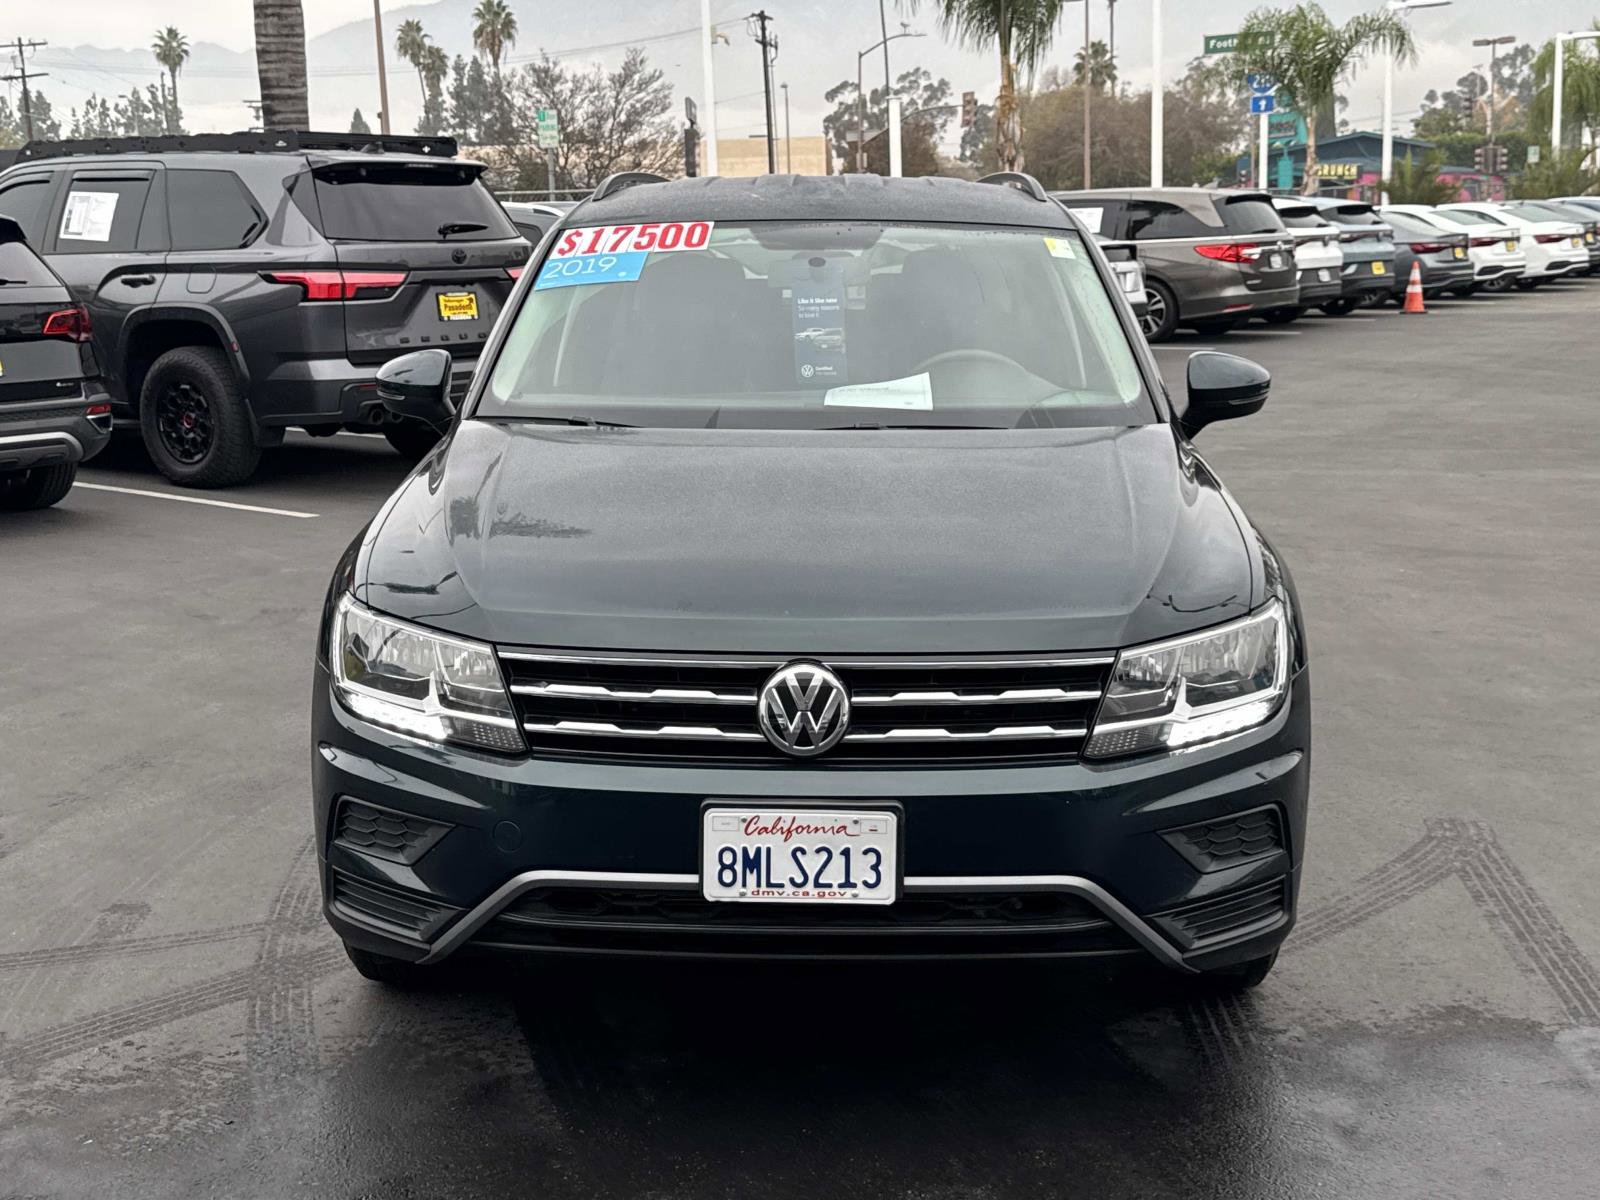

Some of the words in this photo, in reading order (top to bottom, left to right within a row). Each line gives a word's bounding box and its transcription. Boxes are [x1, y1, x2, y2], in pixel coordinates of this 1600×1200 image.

[557, 223, 710, 256] $17500
[543, 256, 617, 279] 2019
[744, 815, 860, 843] California
[717, 846, 882, 889] 8MLS213
[751, 889, 847, 897] dmv.ca.gov
